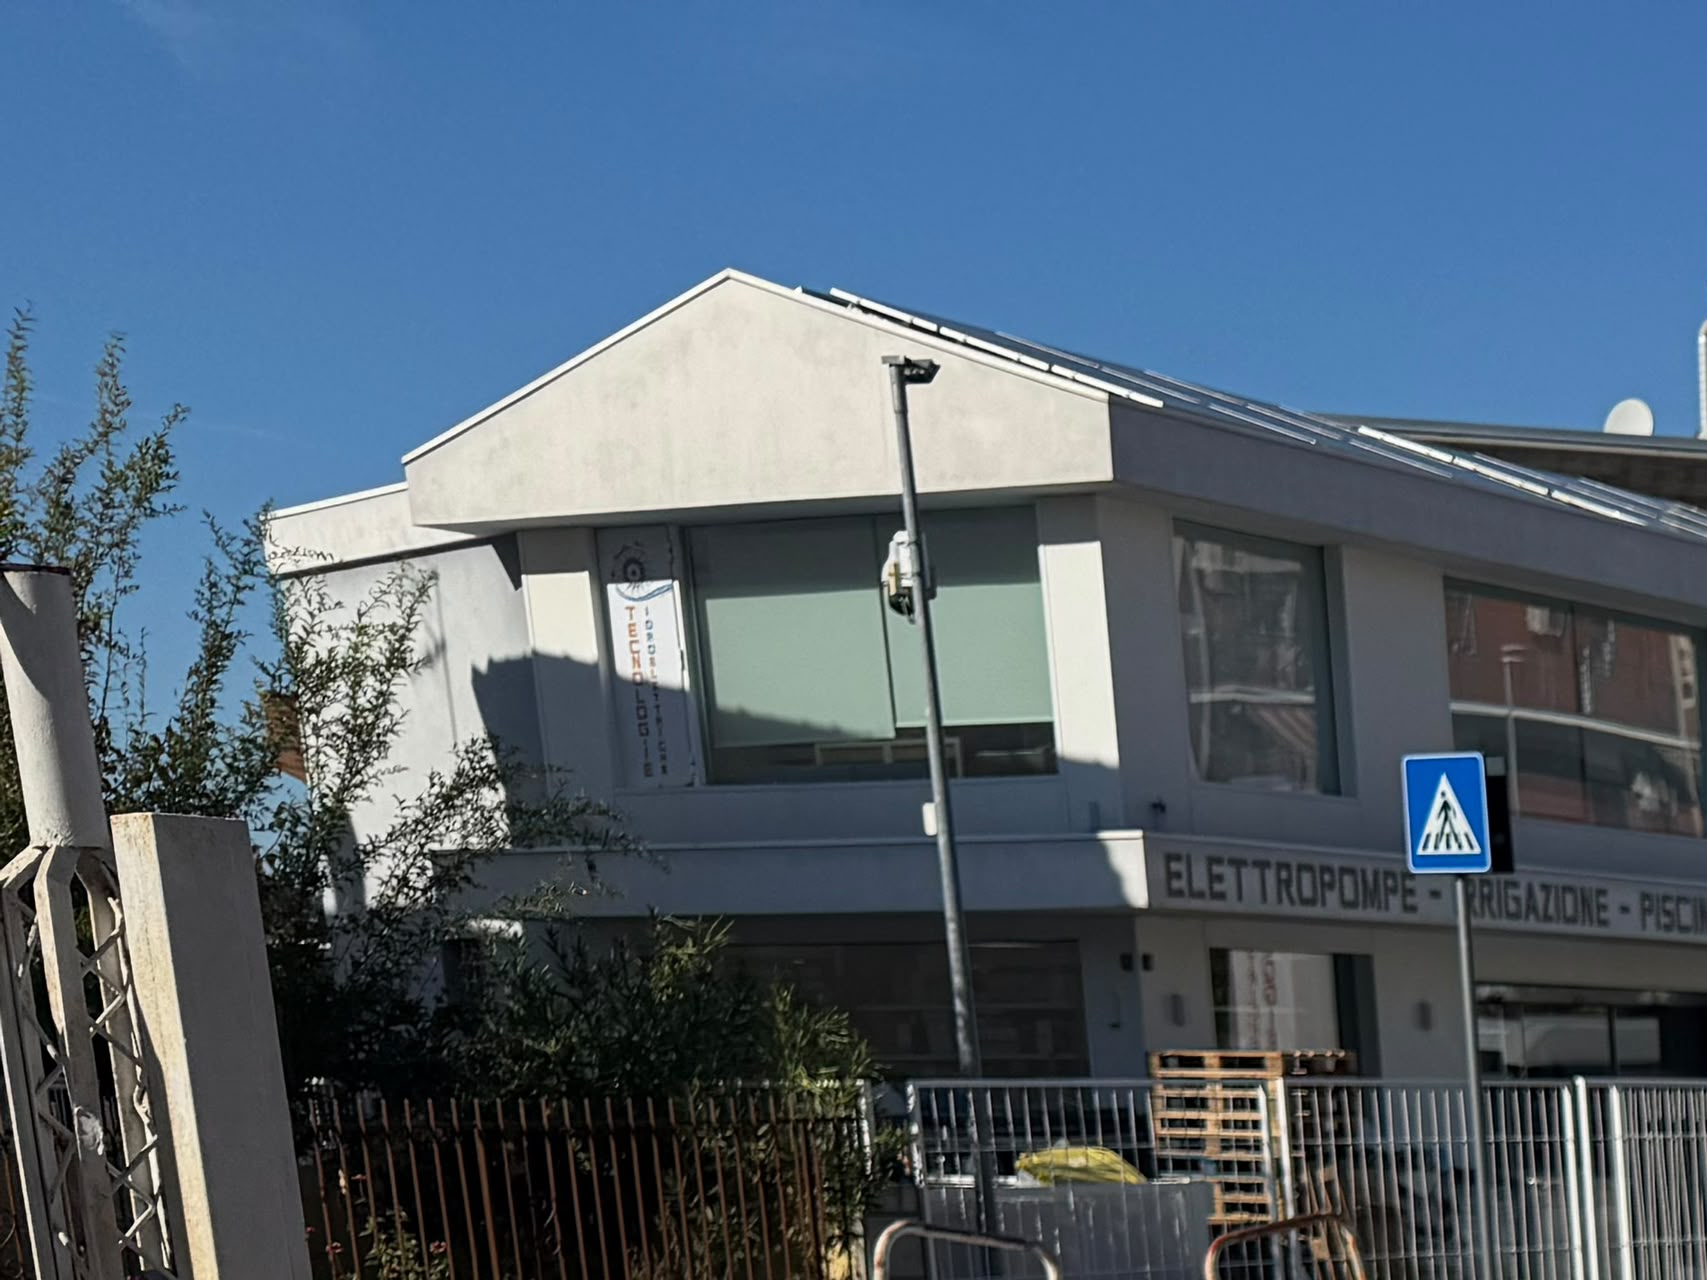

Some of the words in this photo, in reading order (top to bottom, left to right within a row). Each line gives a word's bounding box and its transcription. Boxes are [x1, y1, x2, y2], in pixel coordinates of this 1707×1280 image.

[625, 606, 653, 777] TECNOLOGIE
[1164, 853, 1418, 913] ELETTROPOMPE
[1462, 877, 1610, 928] RRIGAZIONE
